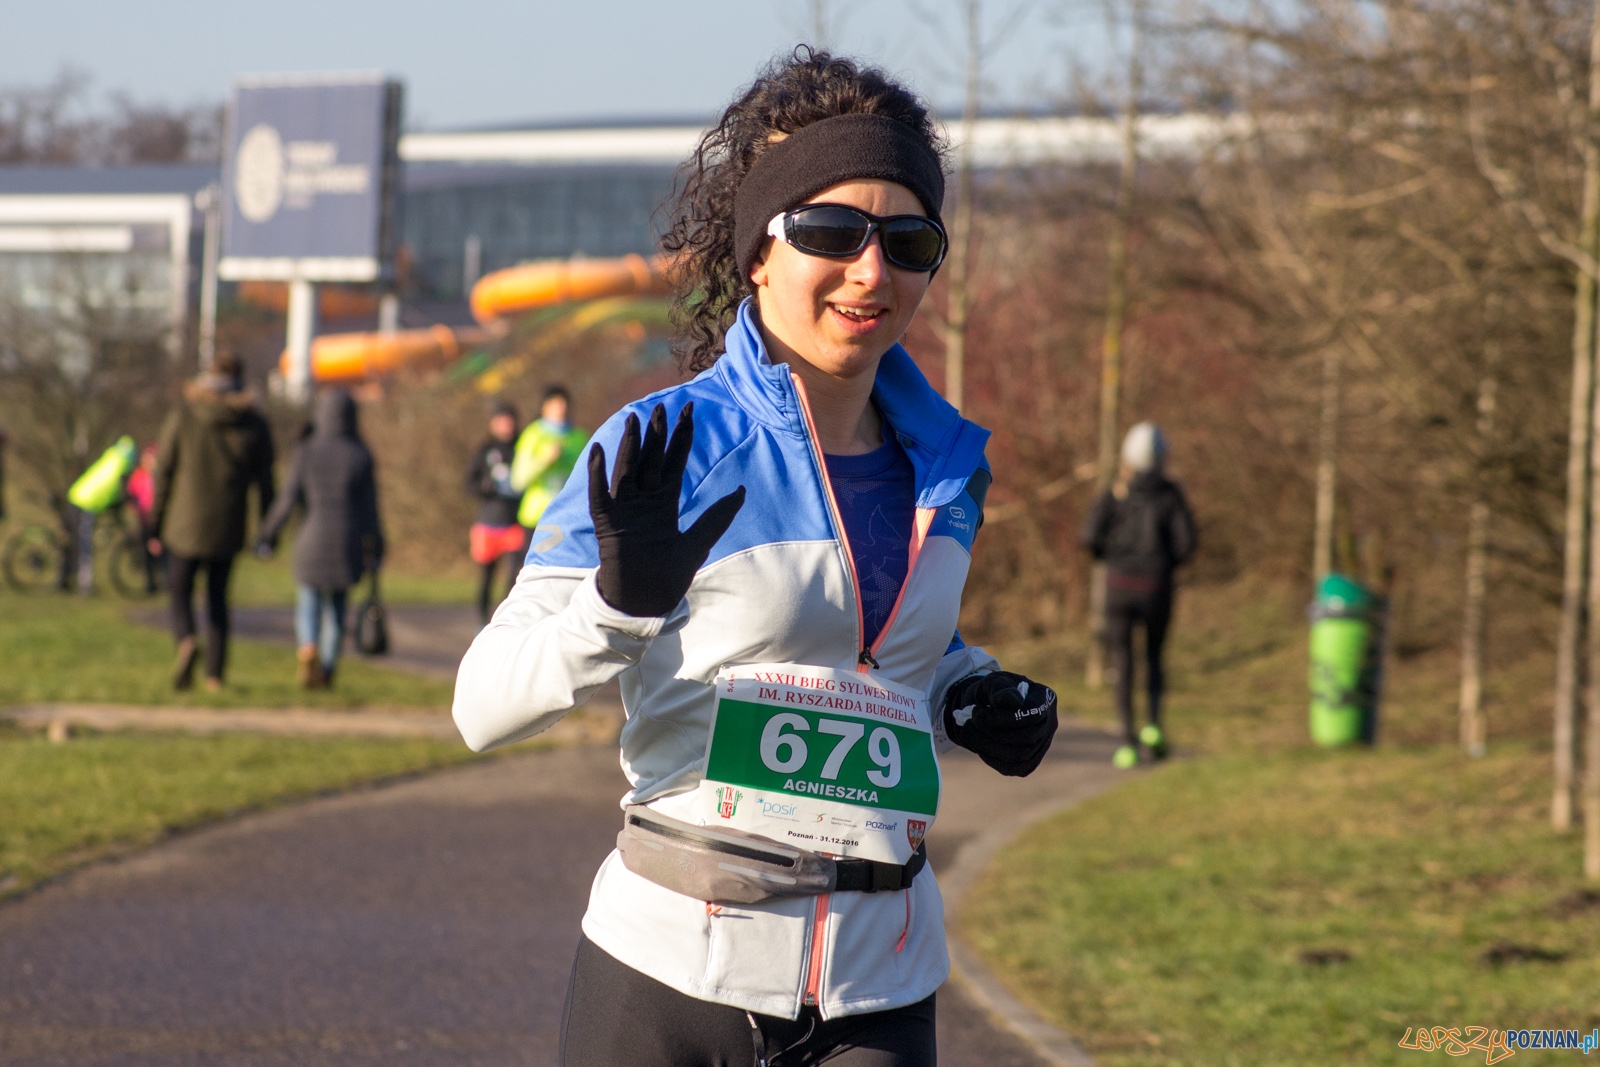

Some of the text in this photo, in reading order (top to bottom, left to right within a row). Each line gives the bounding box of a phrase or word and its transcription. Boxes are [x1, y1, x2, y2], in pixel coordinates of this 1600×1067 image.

[753, 672, 917, 710] XXXII BIEG SYLWESTROWY
[757, 687, 781, 701] IM.
[785, 690, 862, 712] RYSZARDA
[865, 703, 917, 724] BURGIELA
[758, 712, 902, 789] 679
[783, 778, 879, 803] AGNIESZKA
[762, 801, 797, 816] posir
[787, 830, 814, 840] Poznań
[819, 835, 859, 847] 31.12.2016
